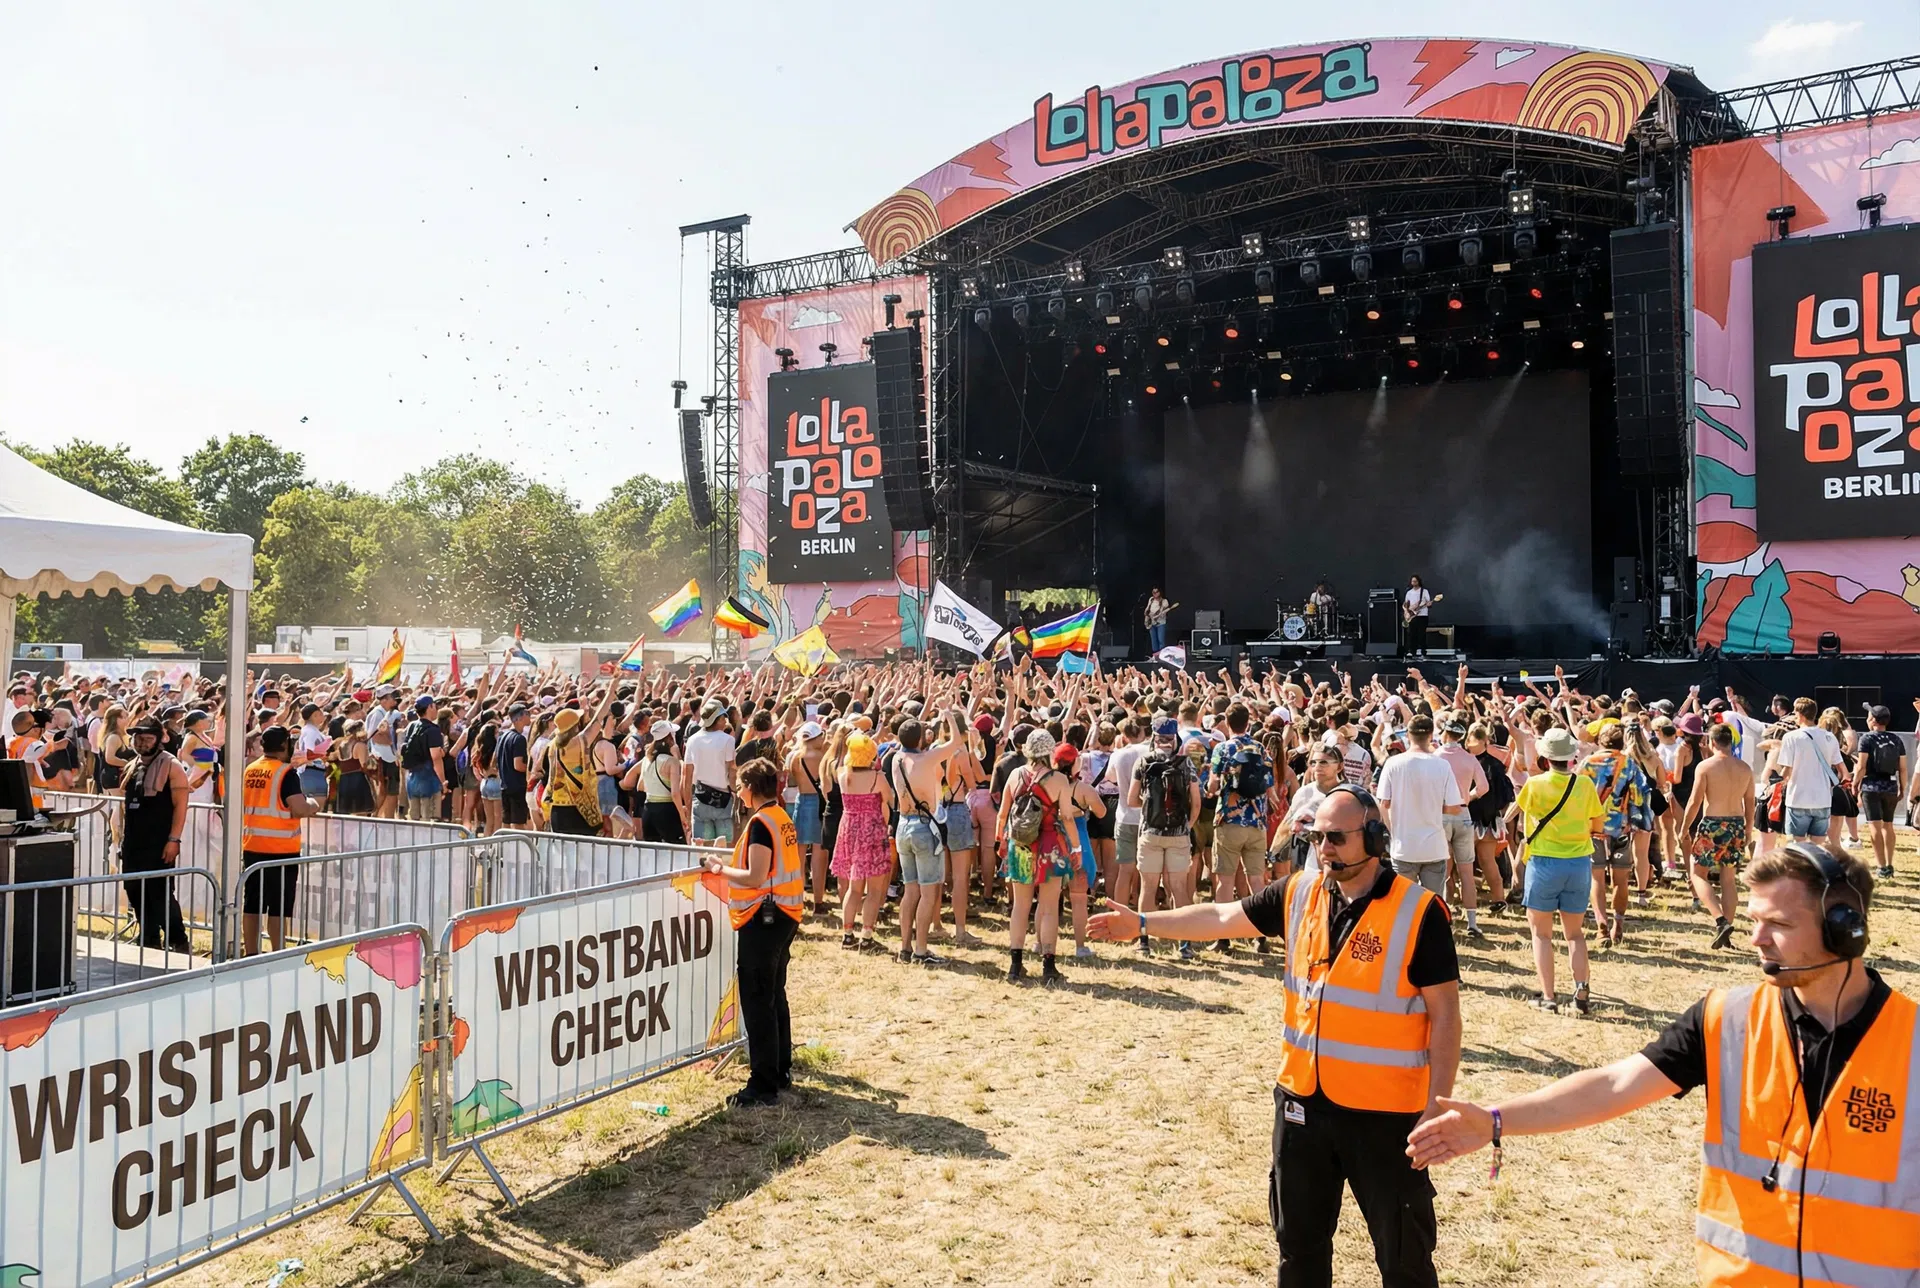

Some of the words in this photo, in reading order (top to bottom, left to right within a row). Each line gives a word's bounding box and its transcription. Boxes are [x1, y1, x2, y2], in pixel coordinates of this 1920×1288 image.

[801, 538, 855, 555] BERLIN
[494, 909, 713, 1011] WRISTBAND
[551, 981, 670, 1067] CHECK
[10, 992, 382, 1164] WRISTBAND
[112, 1093, 315, 1231] CHECK
